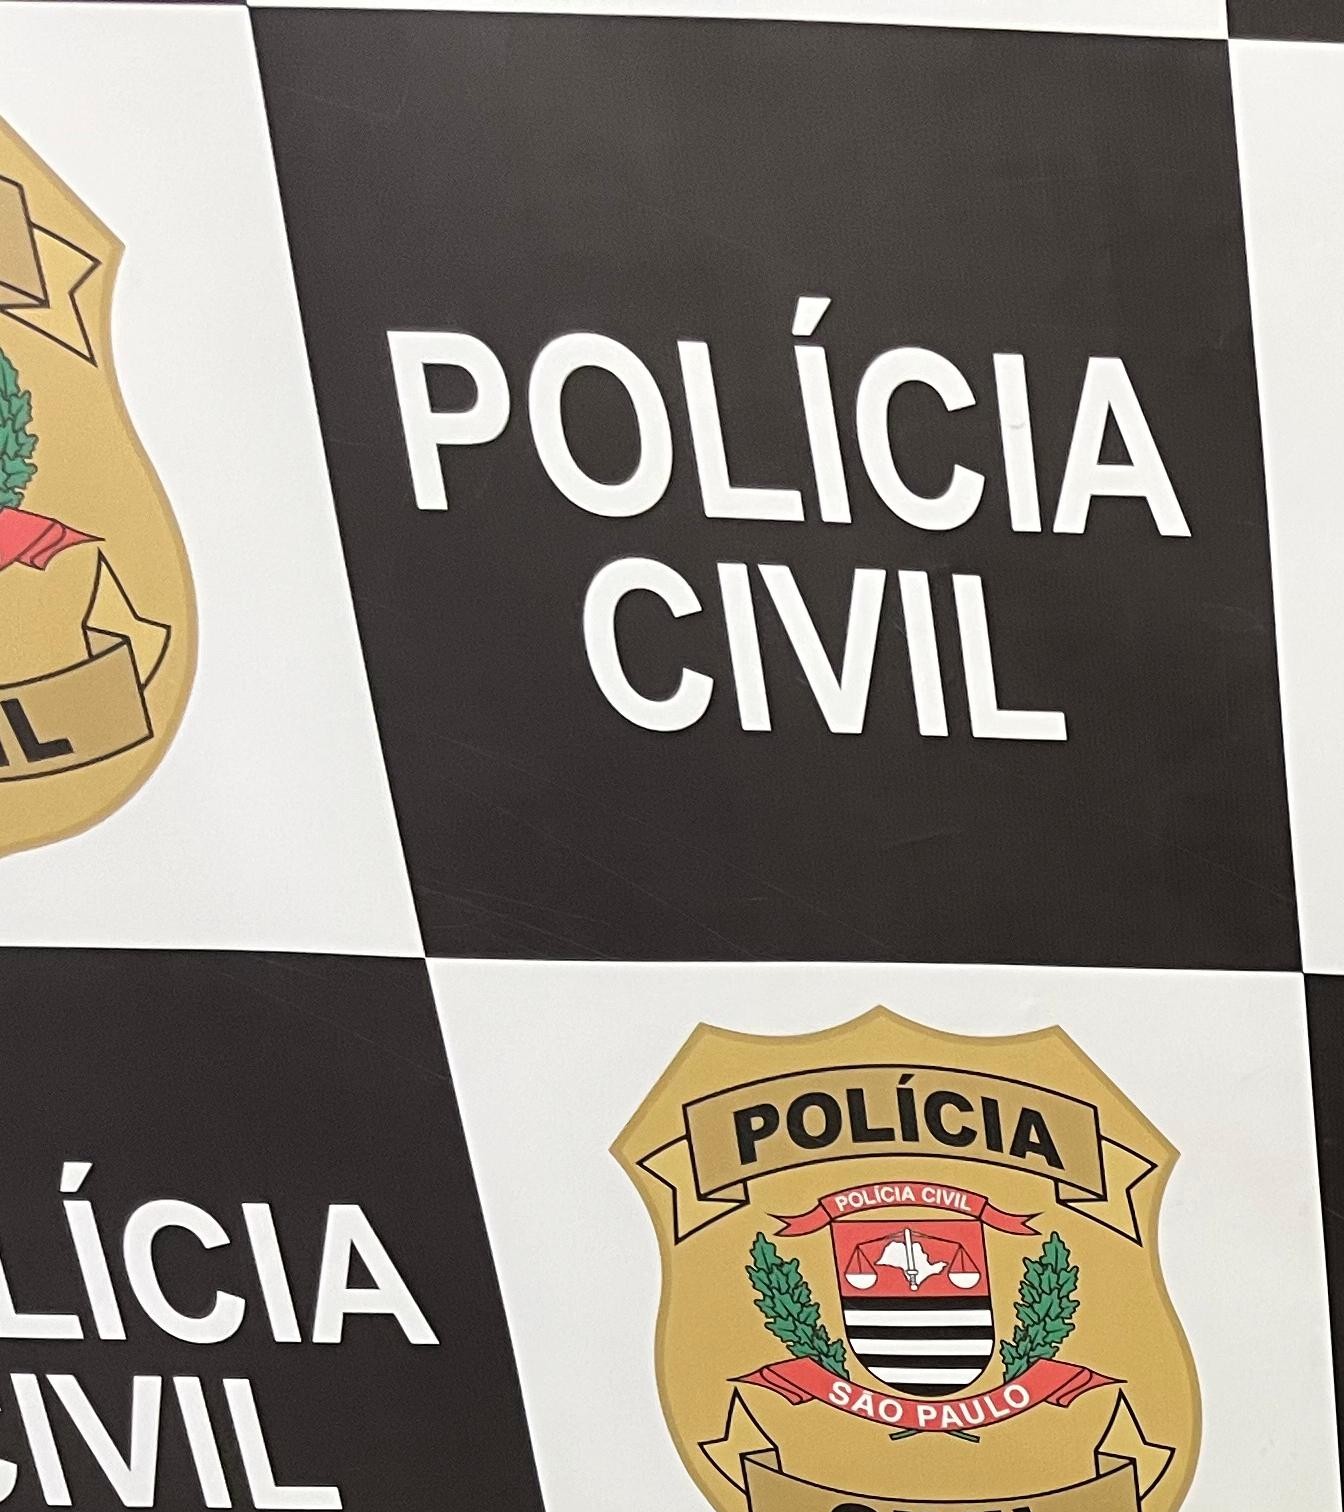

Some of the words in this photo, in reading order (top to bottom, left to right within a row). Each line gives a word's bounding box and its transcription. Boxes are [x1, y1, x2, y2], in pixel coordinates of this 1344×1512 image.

[387, 297, 1191, 537] POLÍCIA
[583, 557, 1067, 740] CIVIL
[733, 1075, 1065, 1169] POLÍCIA
[835, 1185, 915, 1212] POLÍCIA
[921, 1186, 972, 1211] CIVIL
[828, 1381, 903, 1423] SÃO
[917, 1384, 1030, 1429] PAULO
